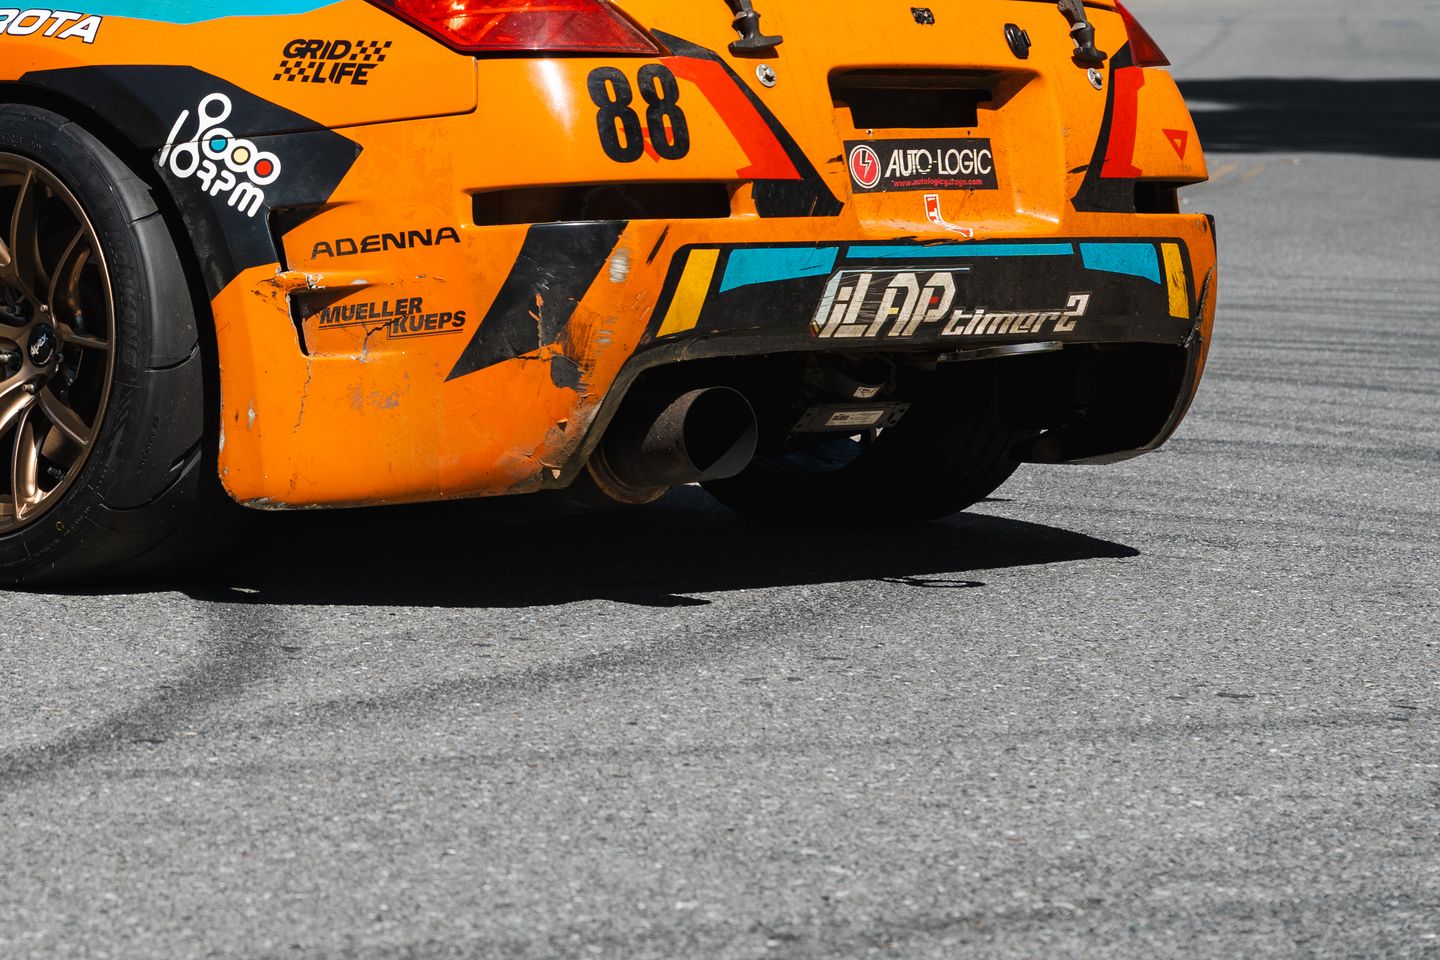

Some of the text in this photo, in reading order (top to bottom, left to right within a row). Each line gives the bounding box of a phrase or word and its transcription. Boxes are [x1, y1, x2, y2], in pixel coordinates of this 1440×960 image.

[282, 38, 353, 61] GRID
[311, 62, 379, 86] LIFE
[587, 63, 691, 163] 88
[884, 148, 992, 178] AUTO-LOGIC
[893, 177, 983, 187] www.autologicgarage.com
[311, 227, 461, 260] ADENNA
[319, 296, 423, 325] MUELLER
[393, 310, 467, 334] KUEPS
